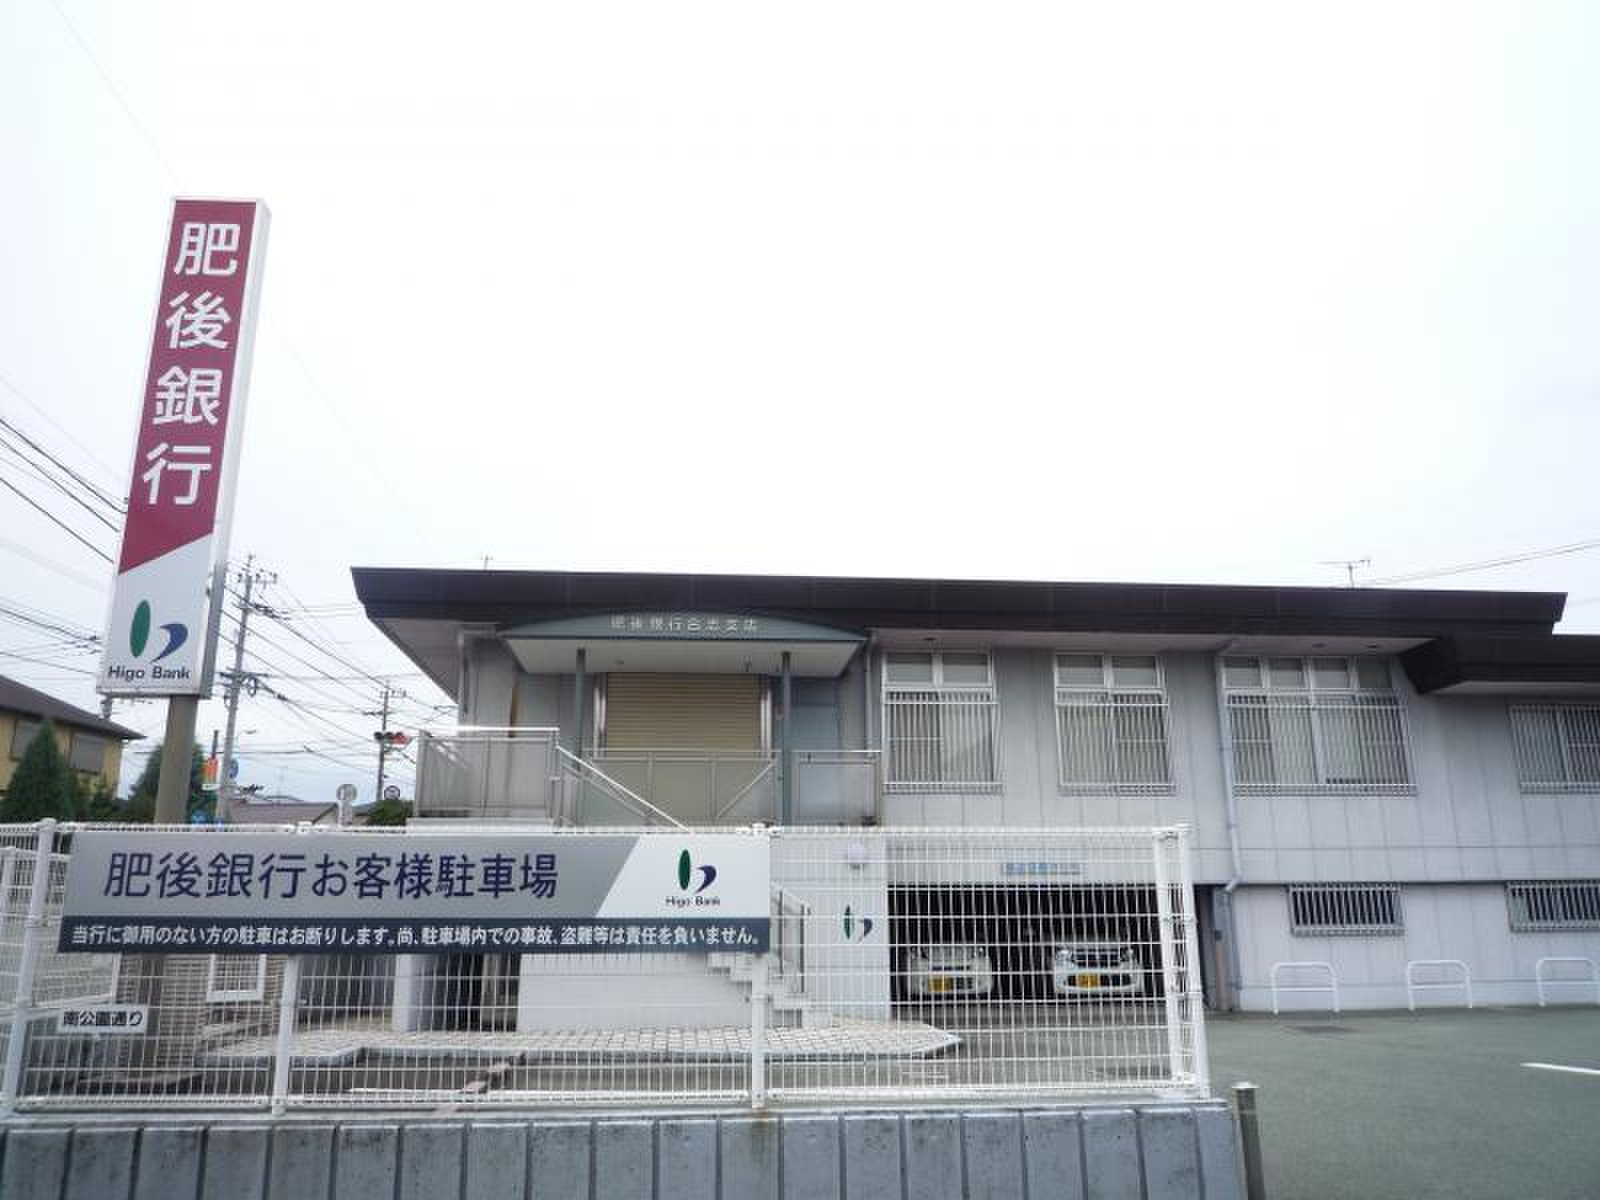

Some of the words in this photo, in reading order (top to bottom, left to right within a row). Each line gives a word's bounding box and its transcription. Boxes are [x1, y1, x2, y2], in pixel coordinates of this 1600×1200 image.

[142, 222, 240, 506] 肥後銀行
[108, 665, 145, 682] Higo
[152, 666, 191, 679] Bank
[104, 851, 558, 900] 肥後銀行お客様駐車場
[665, 895, 690, 908] Higo
[63, 1011, 143, 1026] 南公園通り
